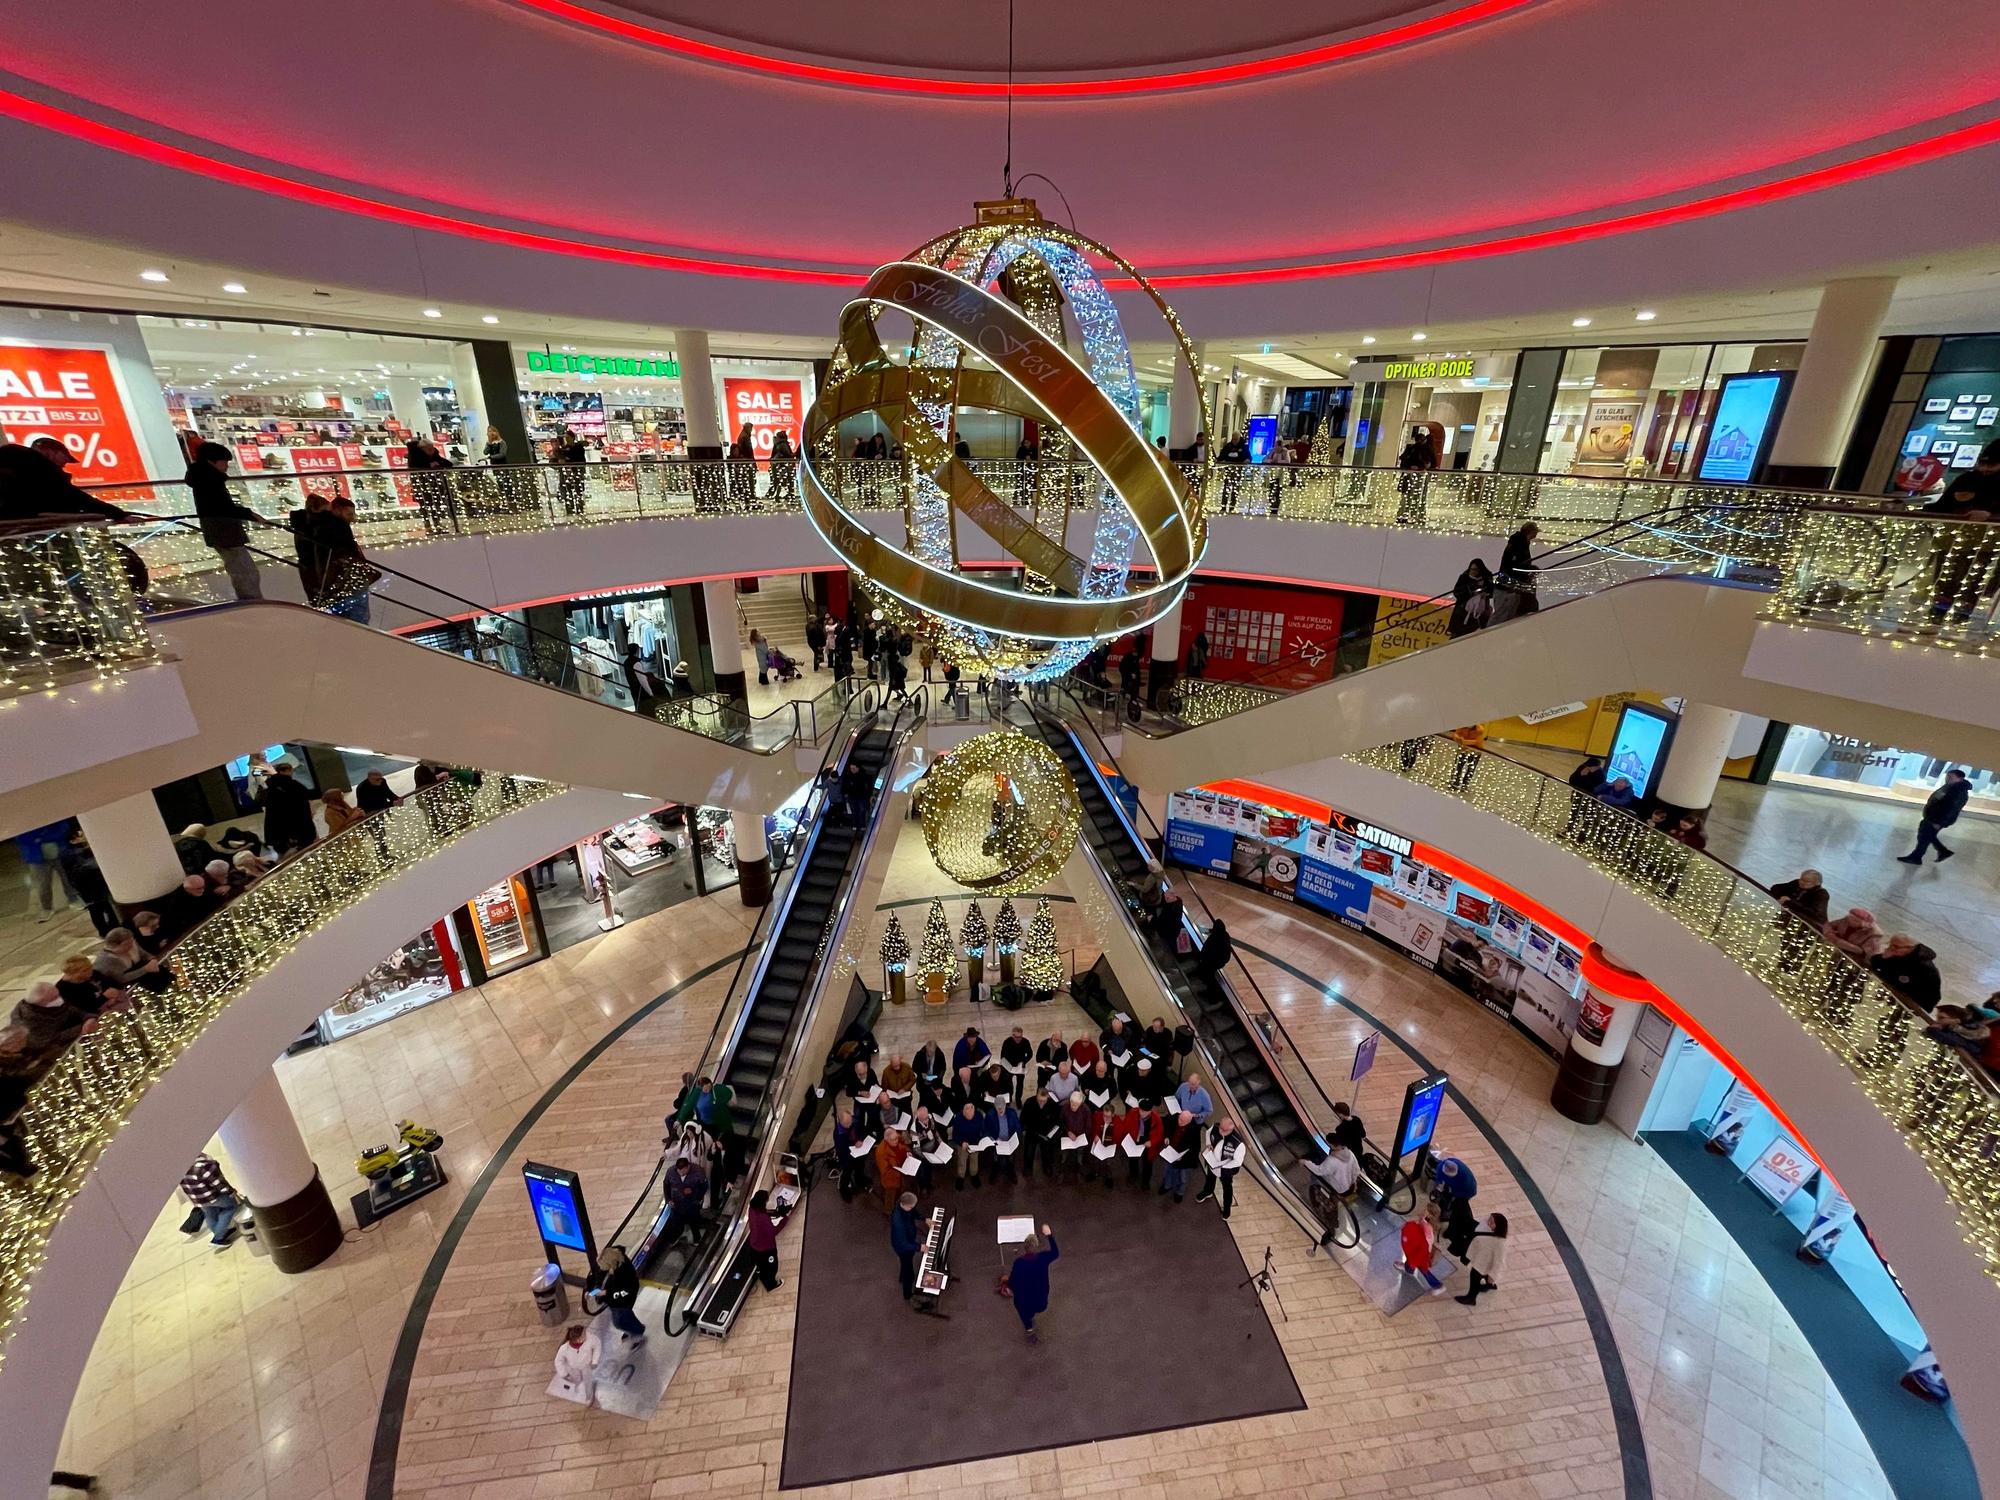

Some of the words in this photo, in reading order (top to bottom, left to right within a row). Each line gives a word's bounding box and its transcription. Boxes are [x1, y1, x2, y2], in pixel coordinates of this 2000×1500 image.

[893, 279, 985, 324] Frohes
[978, 325, 1061, 383] Fest
[1385, 362, 1437, 379] OPTIKER
[1439, 360, 1475, 377] BODE
[736, 391, 793, 410] SALE
[50, 411, 75, 421] BIS
[78, 411, 99, 421] ZU
[298, 457, 337, 468] SALE
[1307, 616, 1333, 625] FREUEN
[1381, 632, 1420, 650] geht
[1831, 751, 1900, 769] BRIGHT
[1168, 840, 1195, 852] SEHEN?
[1169, 833, 1205, 847] GELASSEN
[1356, 823, 1412, 856] SATURN
[1001, 839, 1051, 882] RATHAUS
[1302, 871, 1313, 881] ZU
[1314, 876, 1333, 890] GELD
[1273, 890, 1294, 902] SATURN
[1301, 880, 1338, 901] MACHEN?
[1340, 917, 1363, 932] SATURN
[1411, 953, 1435, 970] SATURN
[1484, 999, 1509, 1019] SATURN
[1771, 1152, 1802, 1178] 0%
